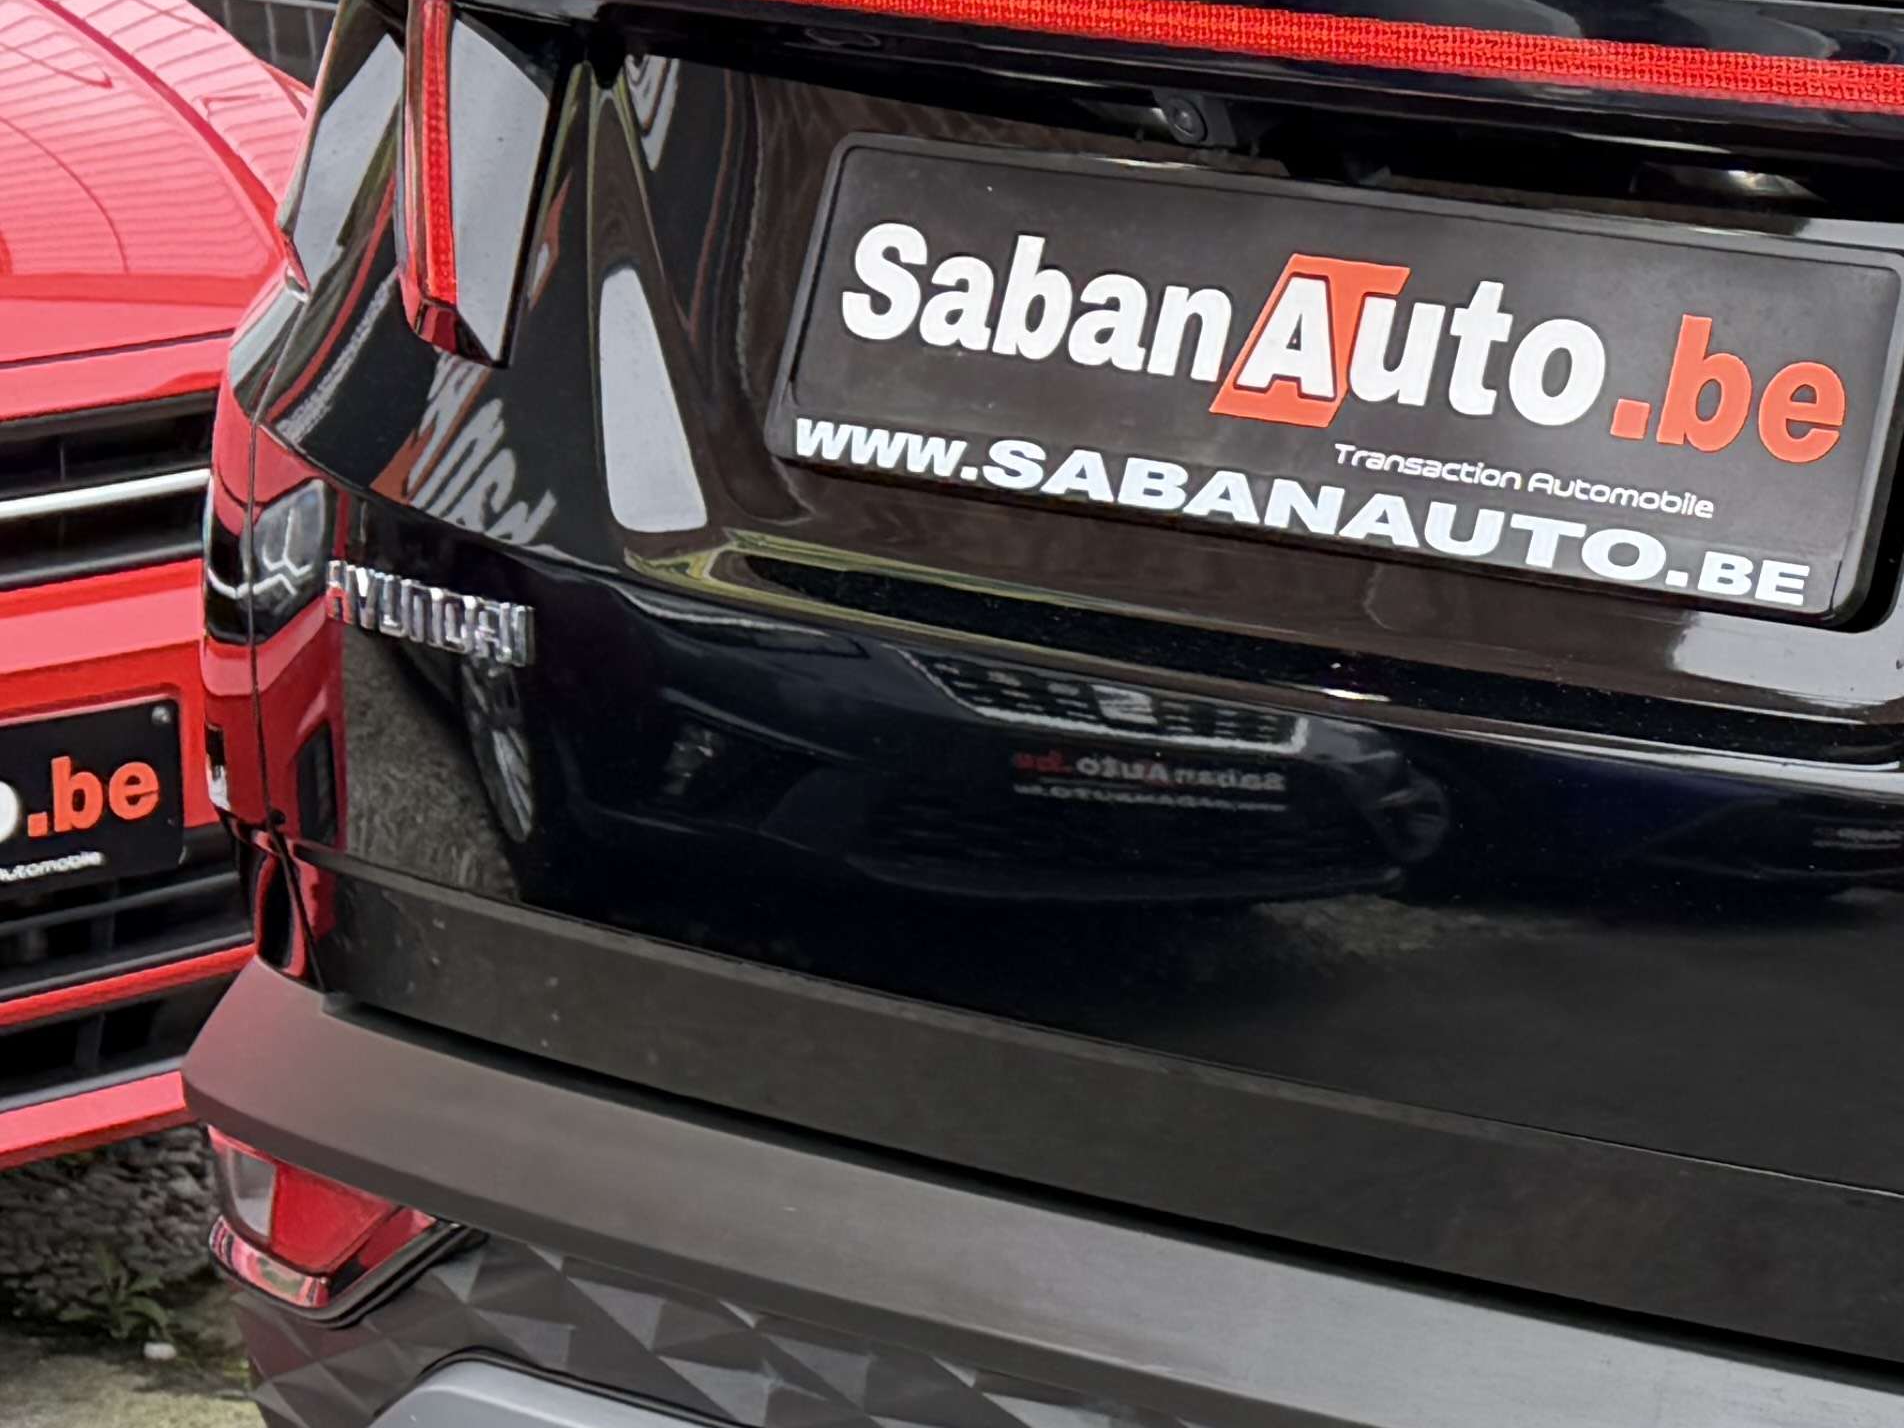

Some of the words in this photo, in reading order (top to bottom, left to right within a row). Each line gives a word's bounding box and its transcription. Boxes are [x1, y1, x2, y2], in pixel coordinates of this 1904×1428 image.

[841, 222, 1846, 464] SabanAuto.be
[796, 418, 1809, 606] www.SABANAUTO.BE
[1334, 442, 1522, 494] Transaction
[1528, 471, 1715, 520] Automobile
